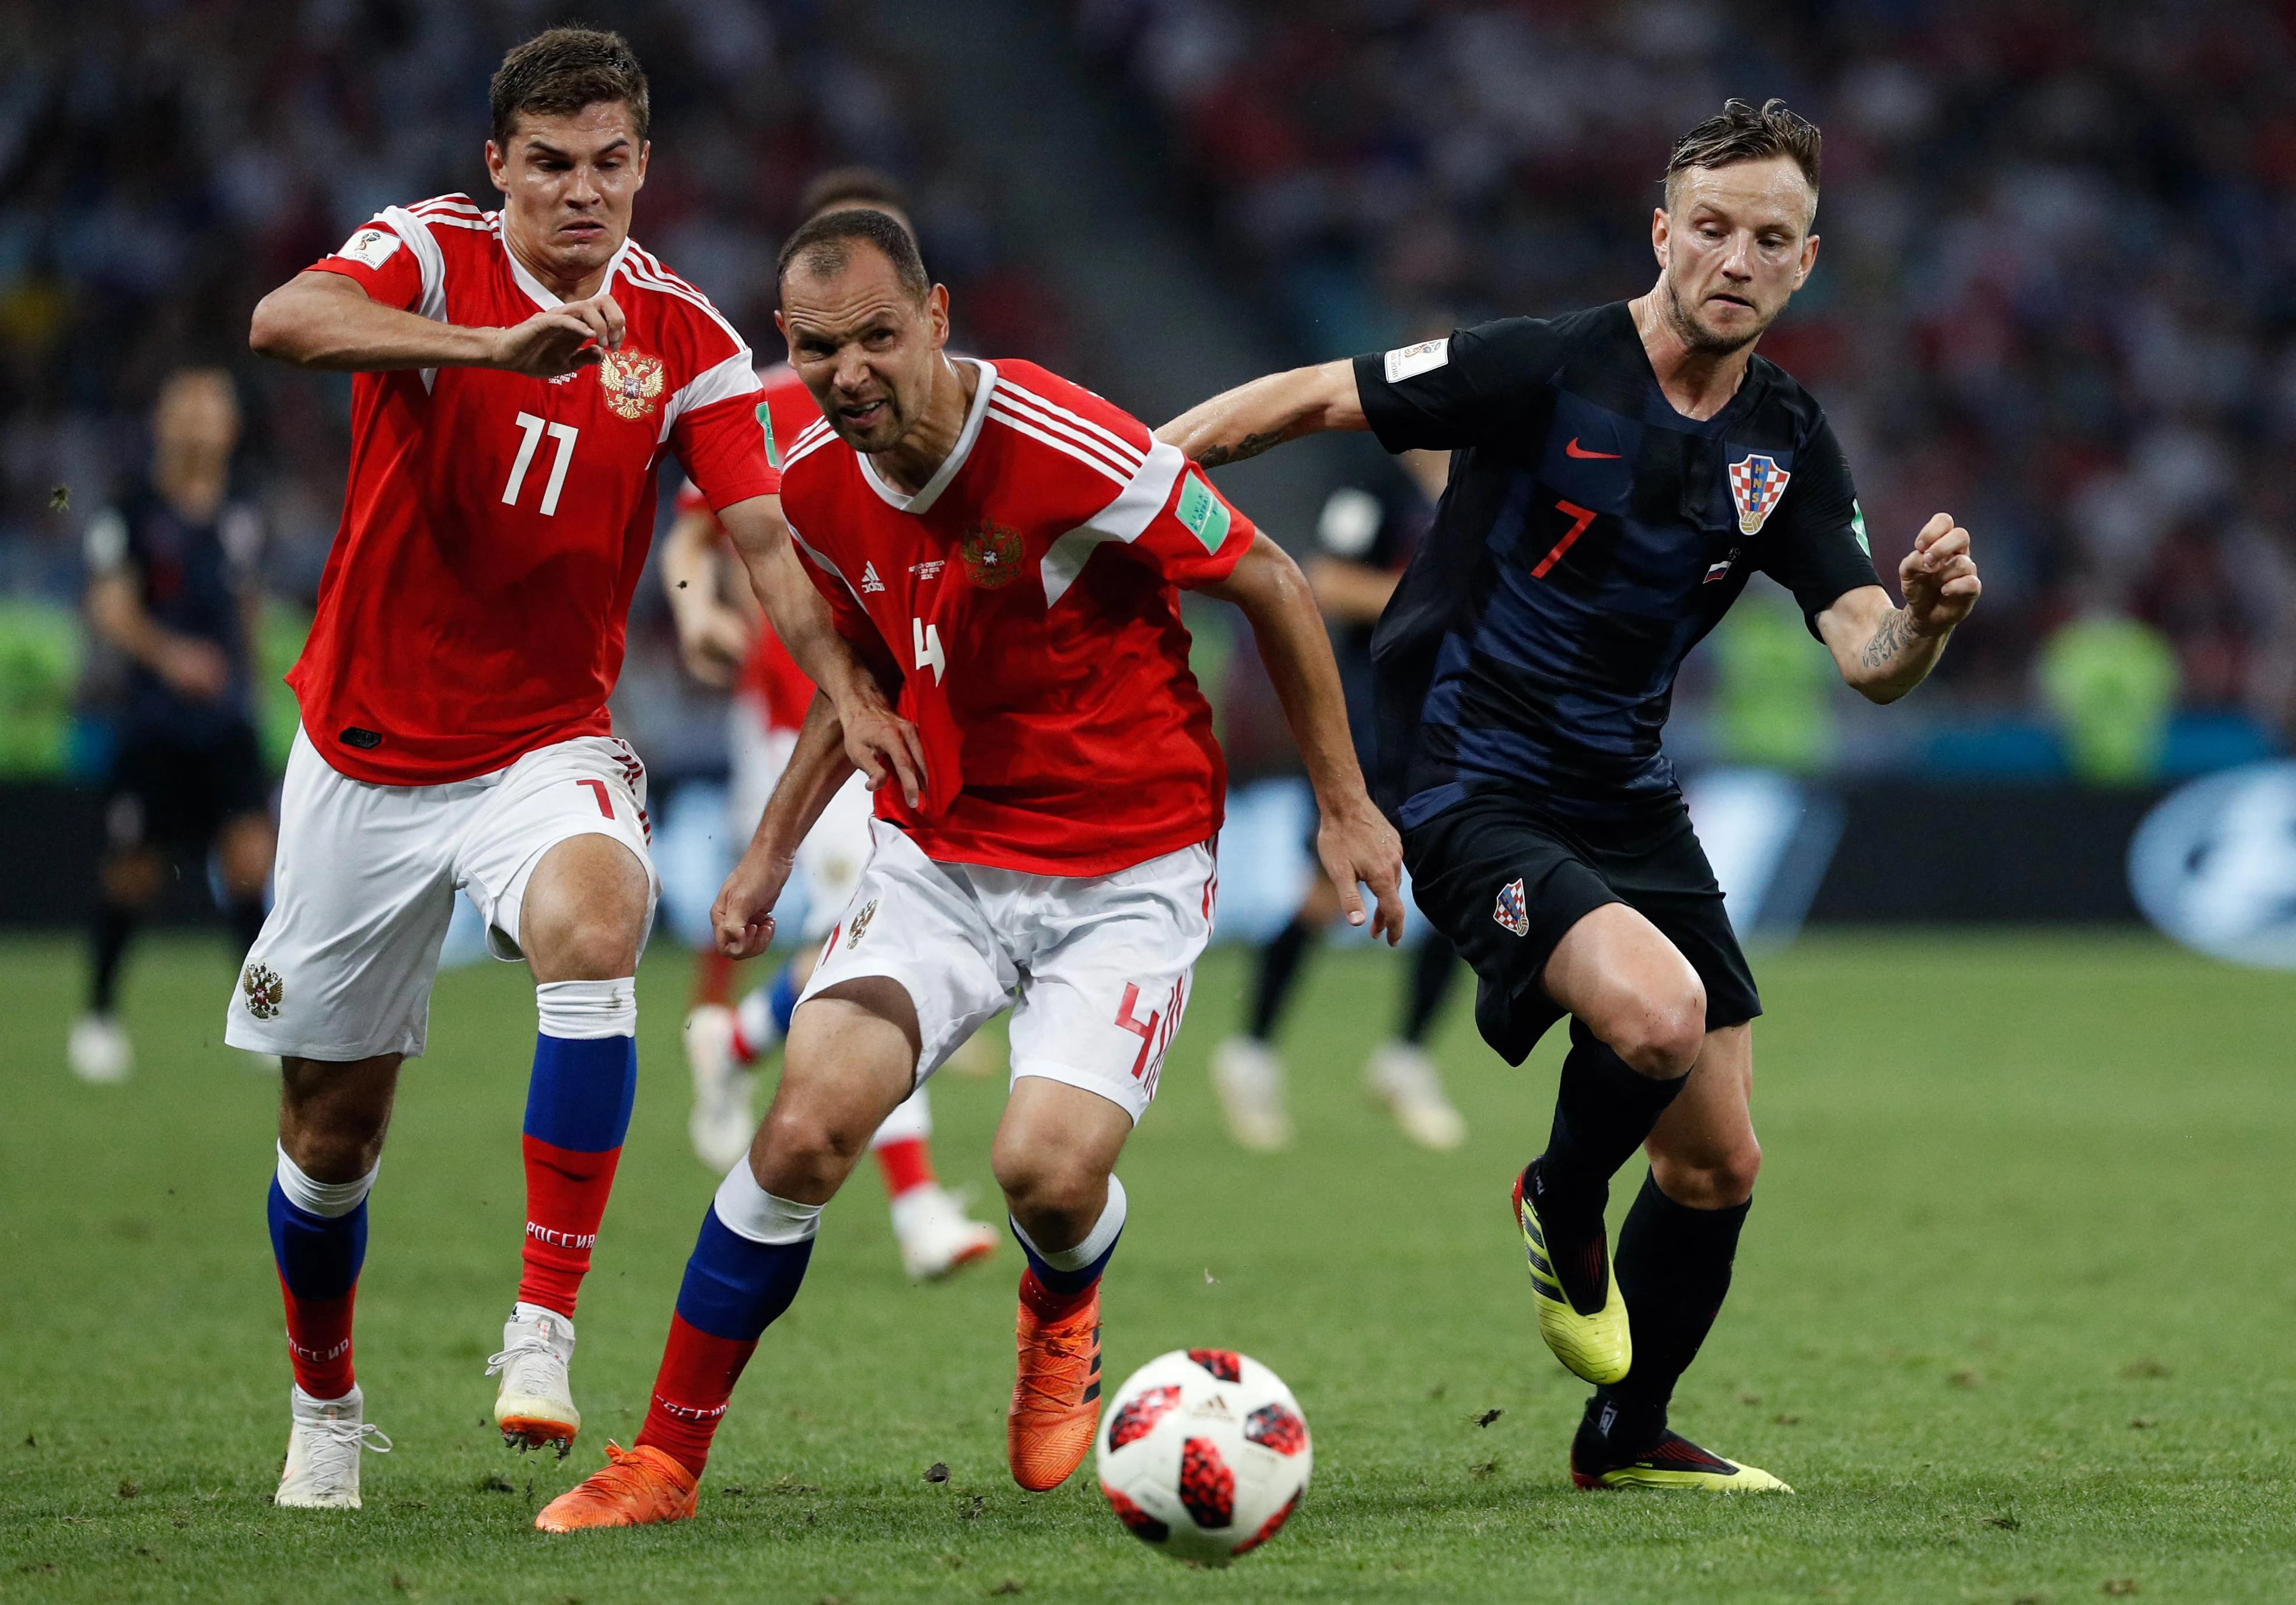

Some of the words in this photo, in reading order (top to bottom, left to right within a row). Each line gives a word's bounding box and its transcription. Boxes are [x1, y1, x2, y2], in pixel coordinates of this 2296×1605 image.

[502, 411, 579, 516] 11
[1752, 464, 1765, 503] HNS
[1531, 500, 1597, 579] 7
[913, 617, 946, 687] 4
[1114, 981, 1160, 1080] 4
[526, 1221, 596, 1249] РОССИЯ
